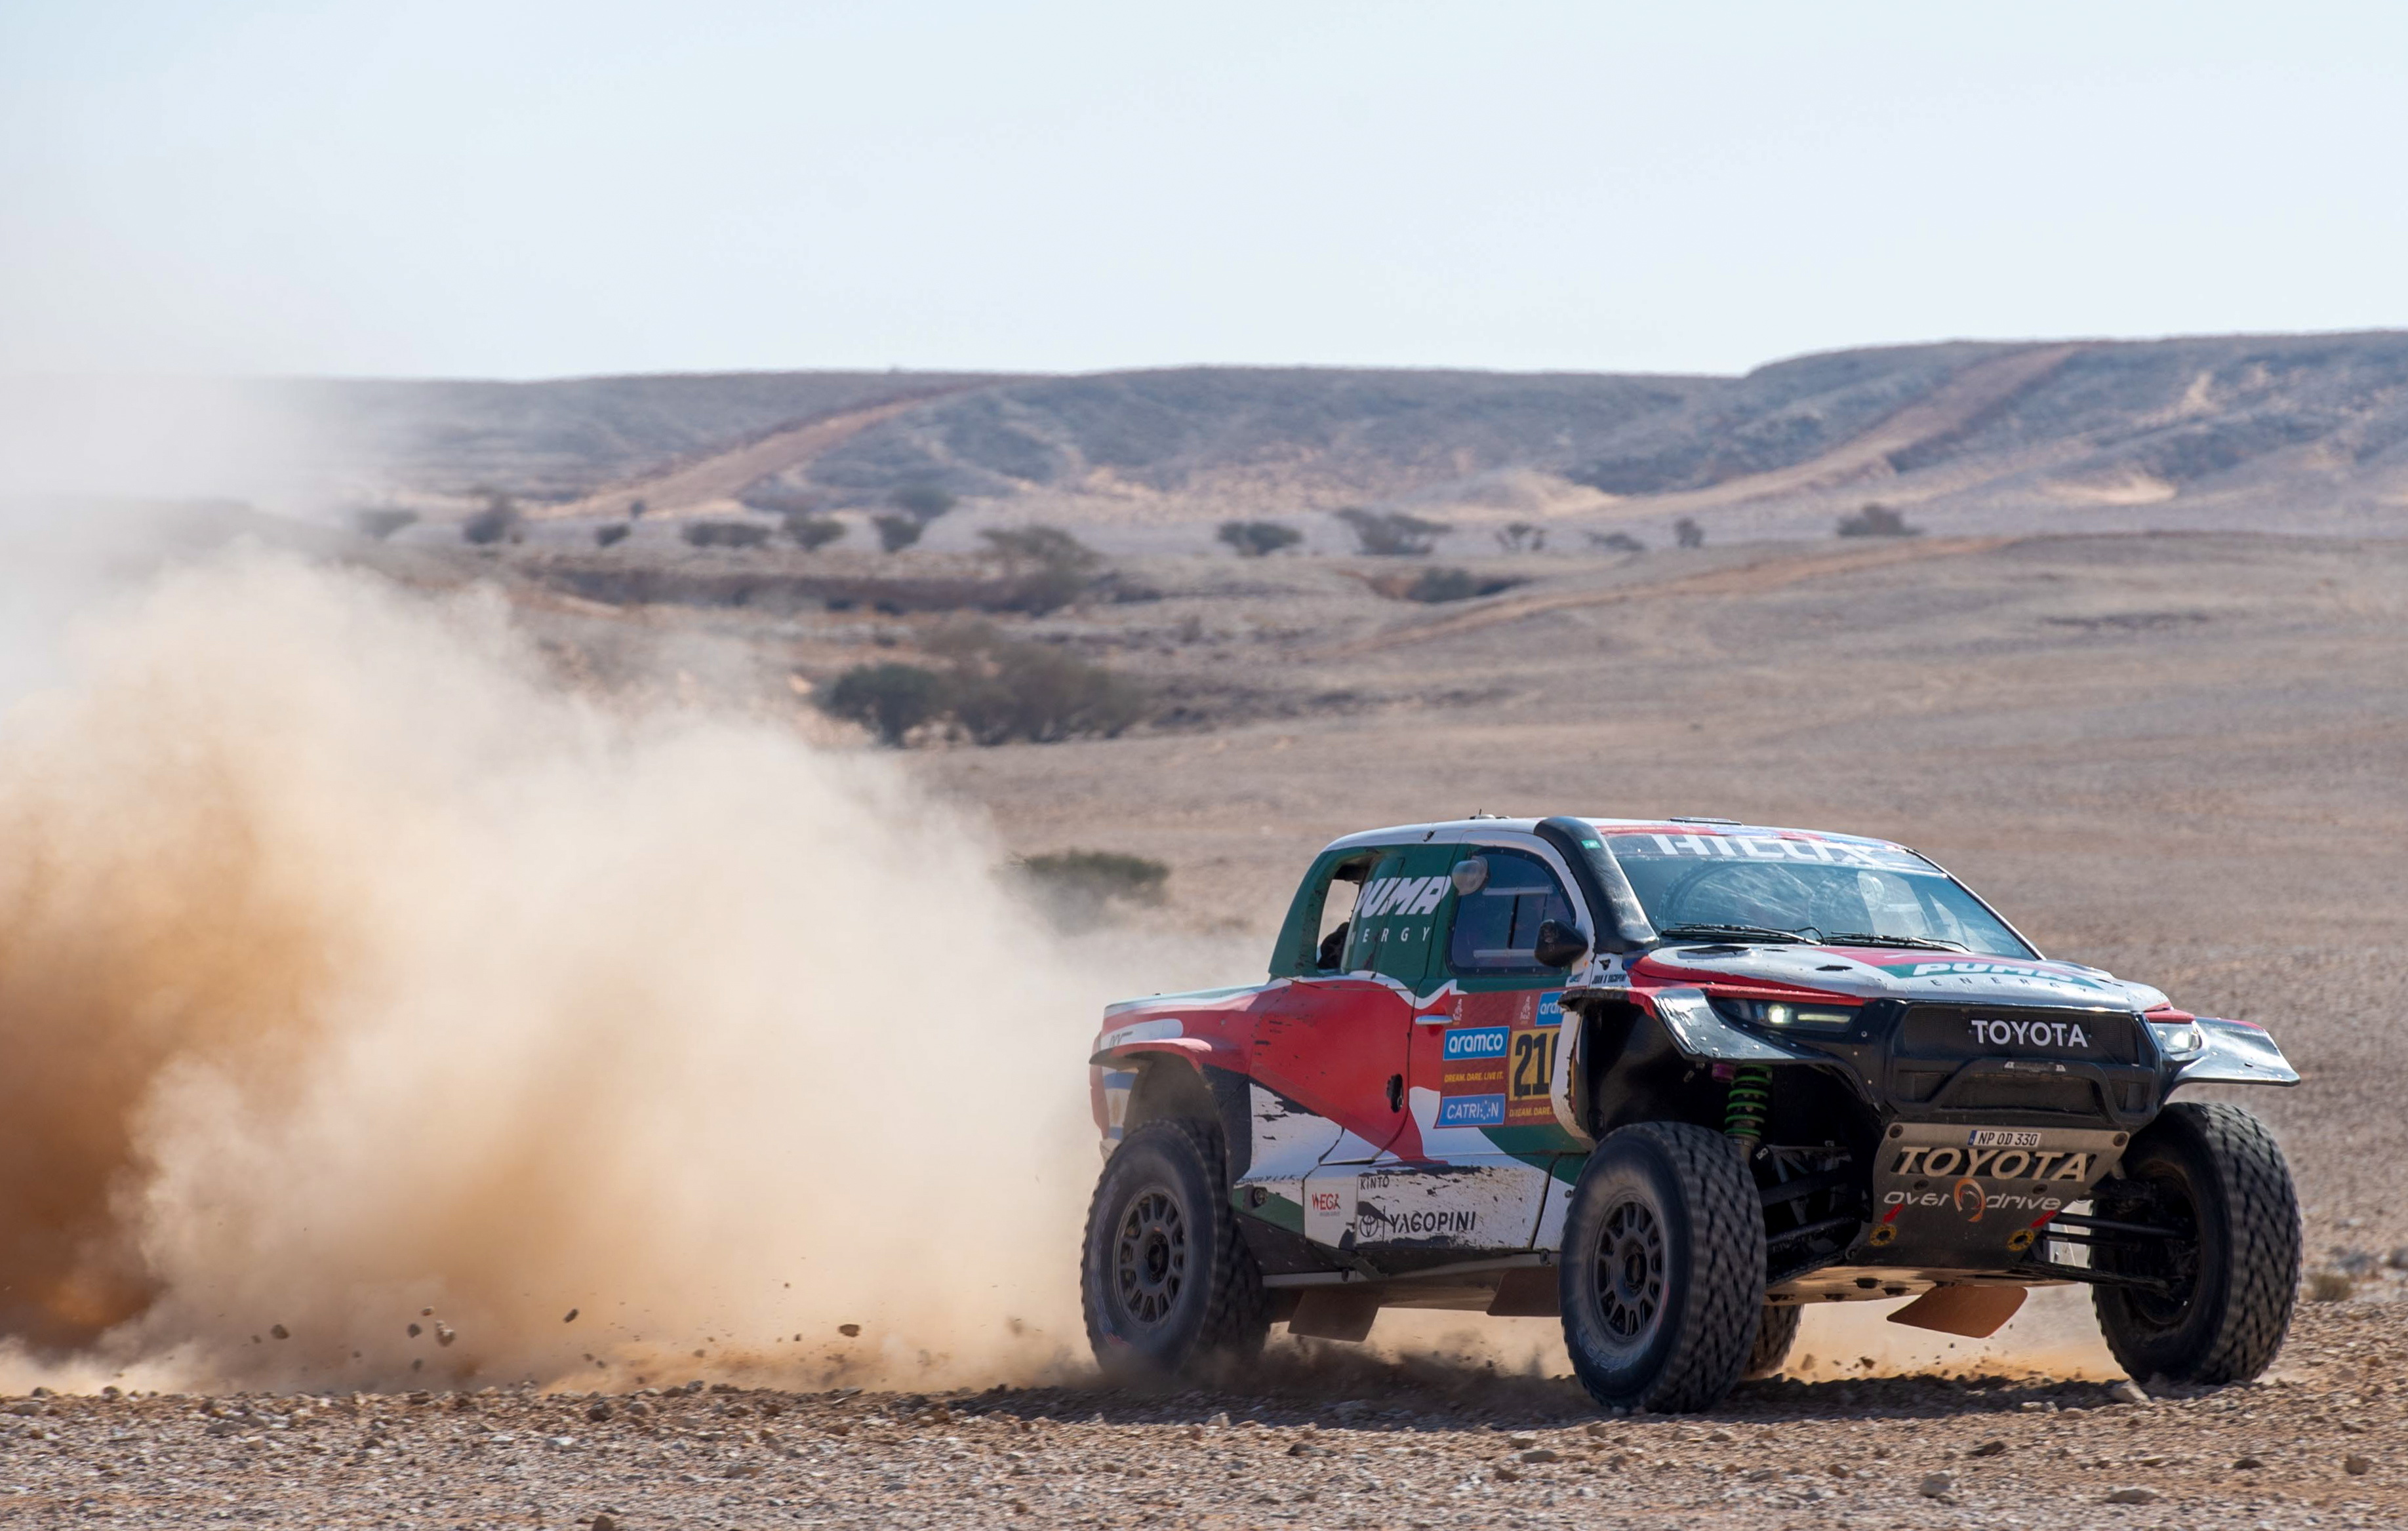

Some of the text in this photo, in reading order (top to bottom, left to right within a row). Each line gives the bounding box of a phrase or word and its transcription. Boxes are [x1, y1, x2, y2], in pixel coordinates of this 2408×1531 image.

[1651, 834, 1886, 867] HILUX
[1354, 875, 1451, 918] PUMA
[1913, 963, 2074, 982] PUMA
[1449, 1033, 1504, 1054] aramco
[1971, 1020, 2088, 1048] TOYOTA
[1444, 1073, 1465, 1082] DREAM.
[1466, 1072, 1483, 1081] DARE.
[1447, 1100, 1499, 1120] CATRION
[1978, 1133, 1995, 1145] NP
[2015, 1134, 2037, 1146] 330
[1902, 1147, 2087, 1182] TOYOTA
[1360, 1176, 1390, 1190] KINTO
[1312, 1192, 1341, 1210] WEGA
[1884, 1191, 2061, 1210] over drive
